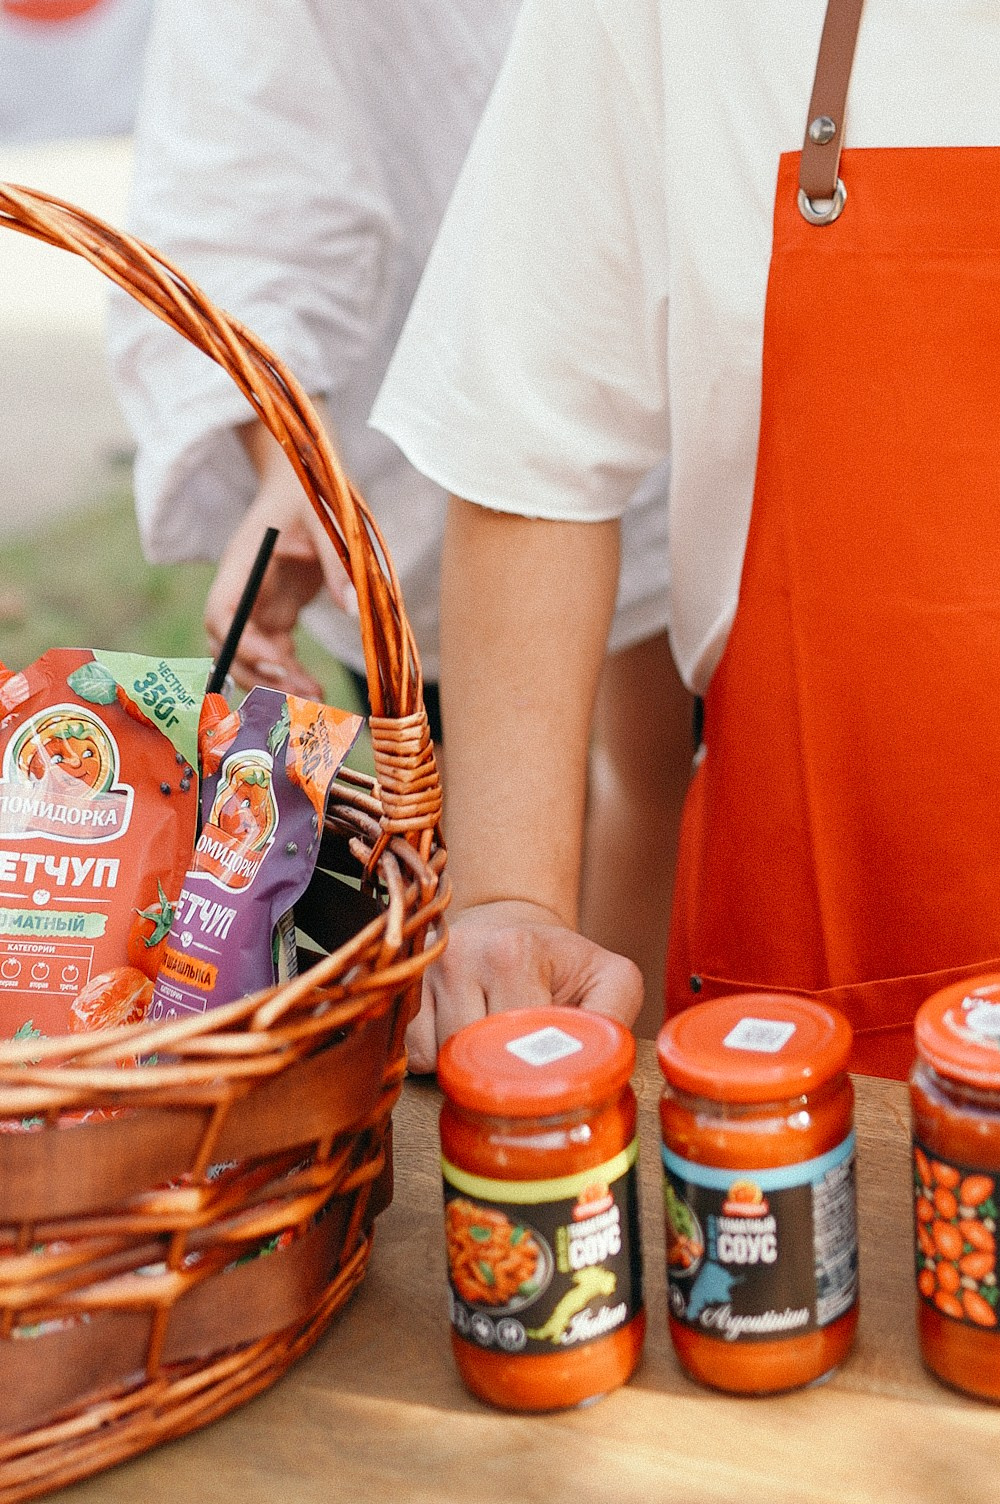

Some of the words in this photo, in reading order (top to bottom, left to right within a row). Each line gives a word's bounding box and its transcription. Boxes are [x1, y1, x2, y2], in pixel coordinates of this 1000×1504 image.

[133, 671, 180, 729] 350г
[158, 661, 196, 711] ЧЕСТНЫЕ
[7, 943, 56, 954] КАТЕГОРИИ
[717, 1233, 778, 1265] СОУС
